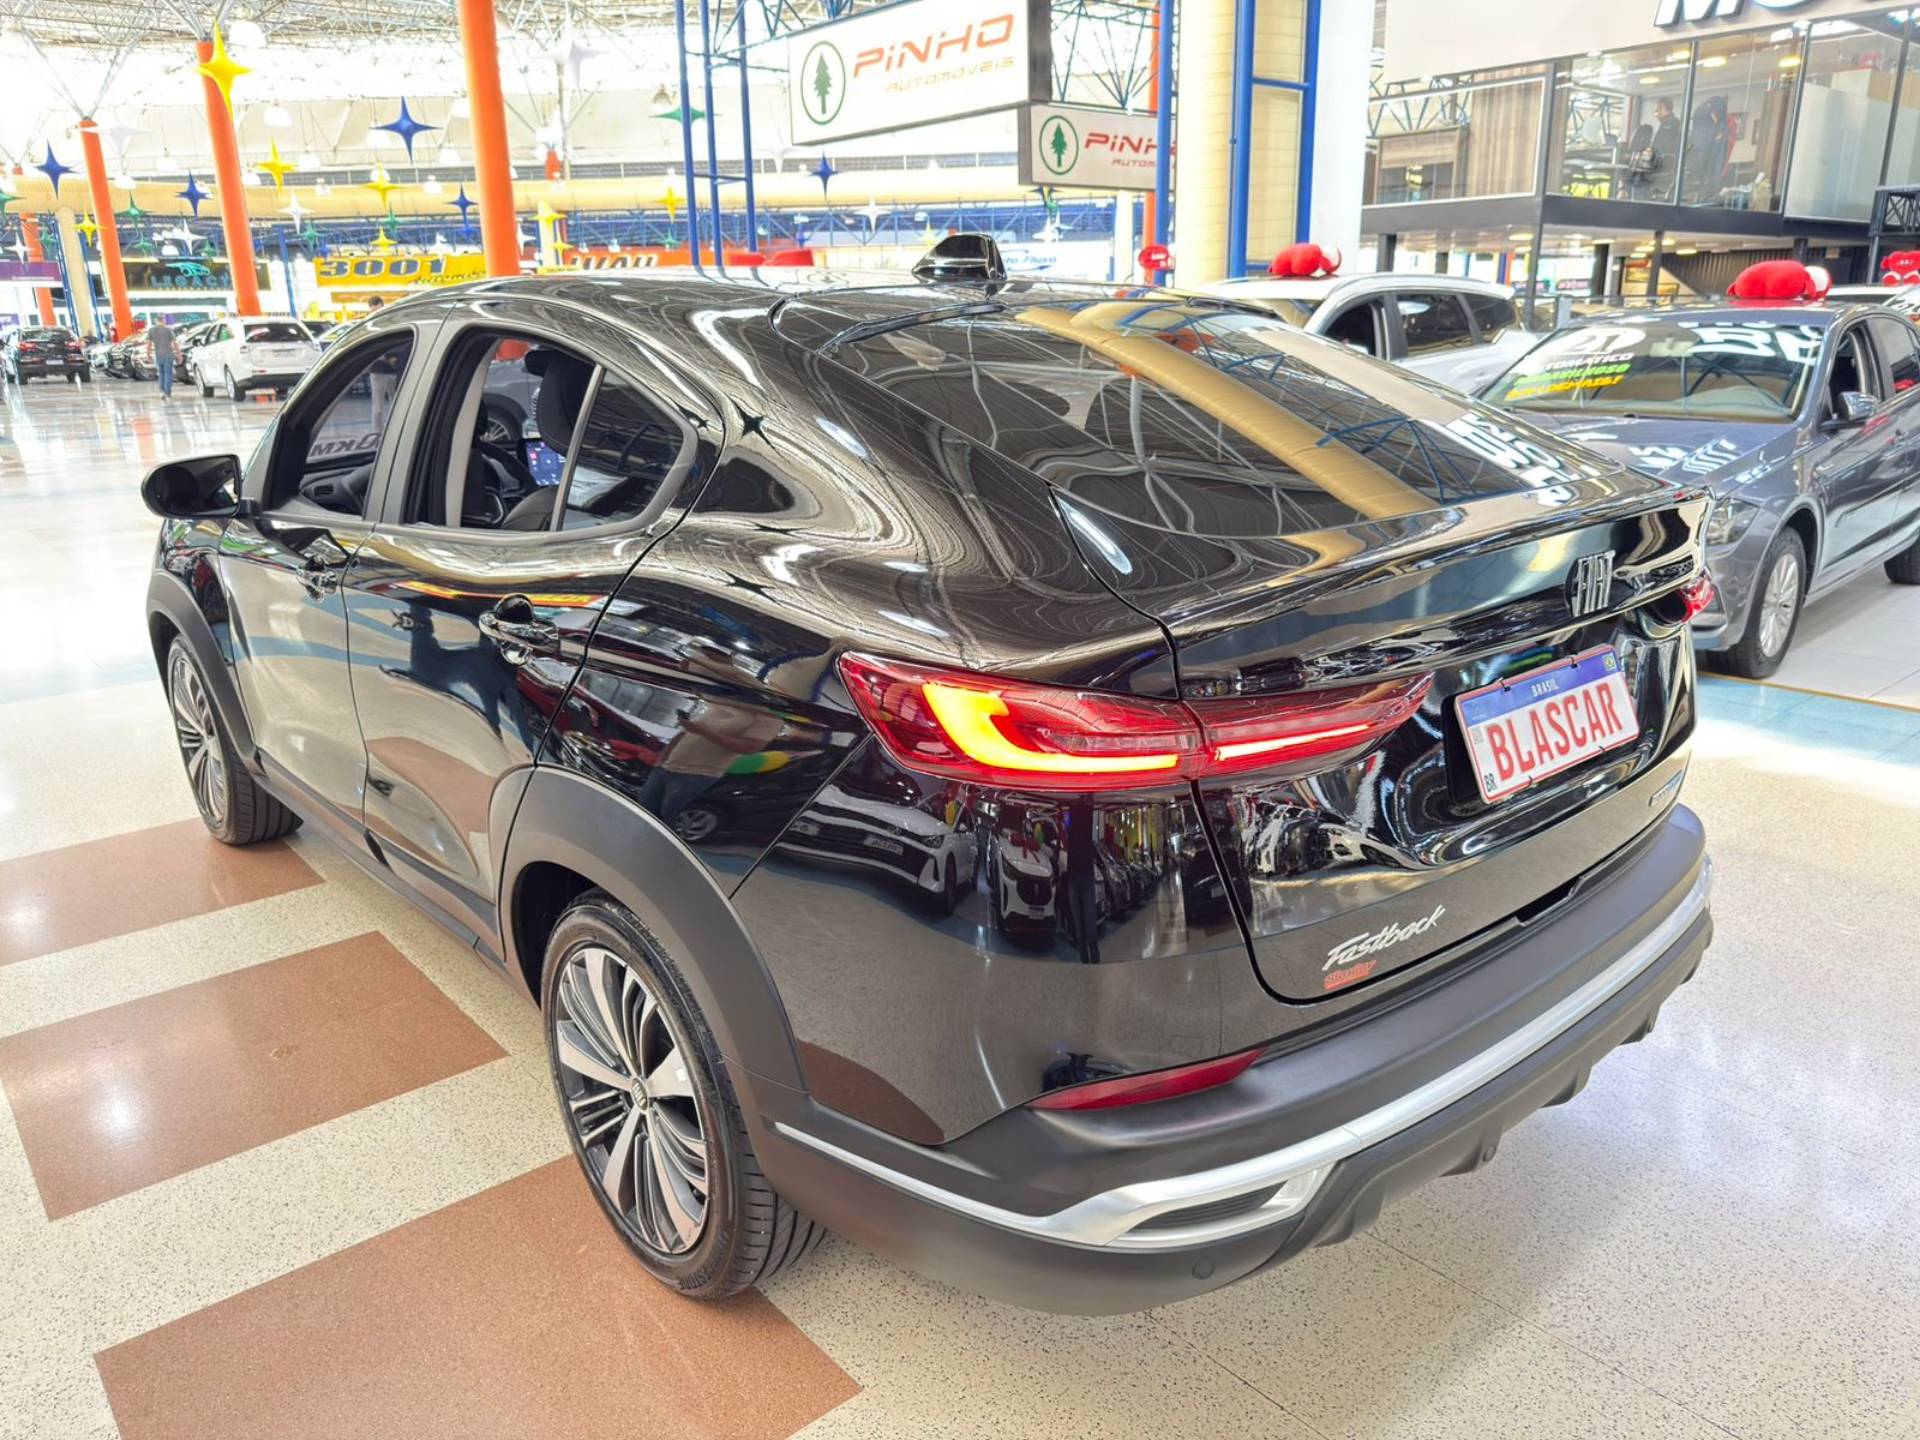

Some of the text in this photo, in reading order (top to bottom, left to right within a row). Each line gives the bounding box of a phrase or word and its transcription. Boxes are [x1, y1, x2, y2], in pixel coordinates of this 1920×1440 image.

[1084, 132, 1177, 156] PiN
[318, 257, 446, 277] 3001
[1531, 679, 1559, 697] BRASIL
[1486, 682, 1623, 781] BLASCAR
[1484, 772, 1497, 792] BR
[1321, 904, 1446, 972] Fastback
